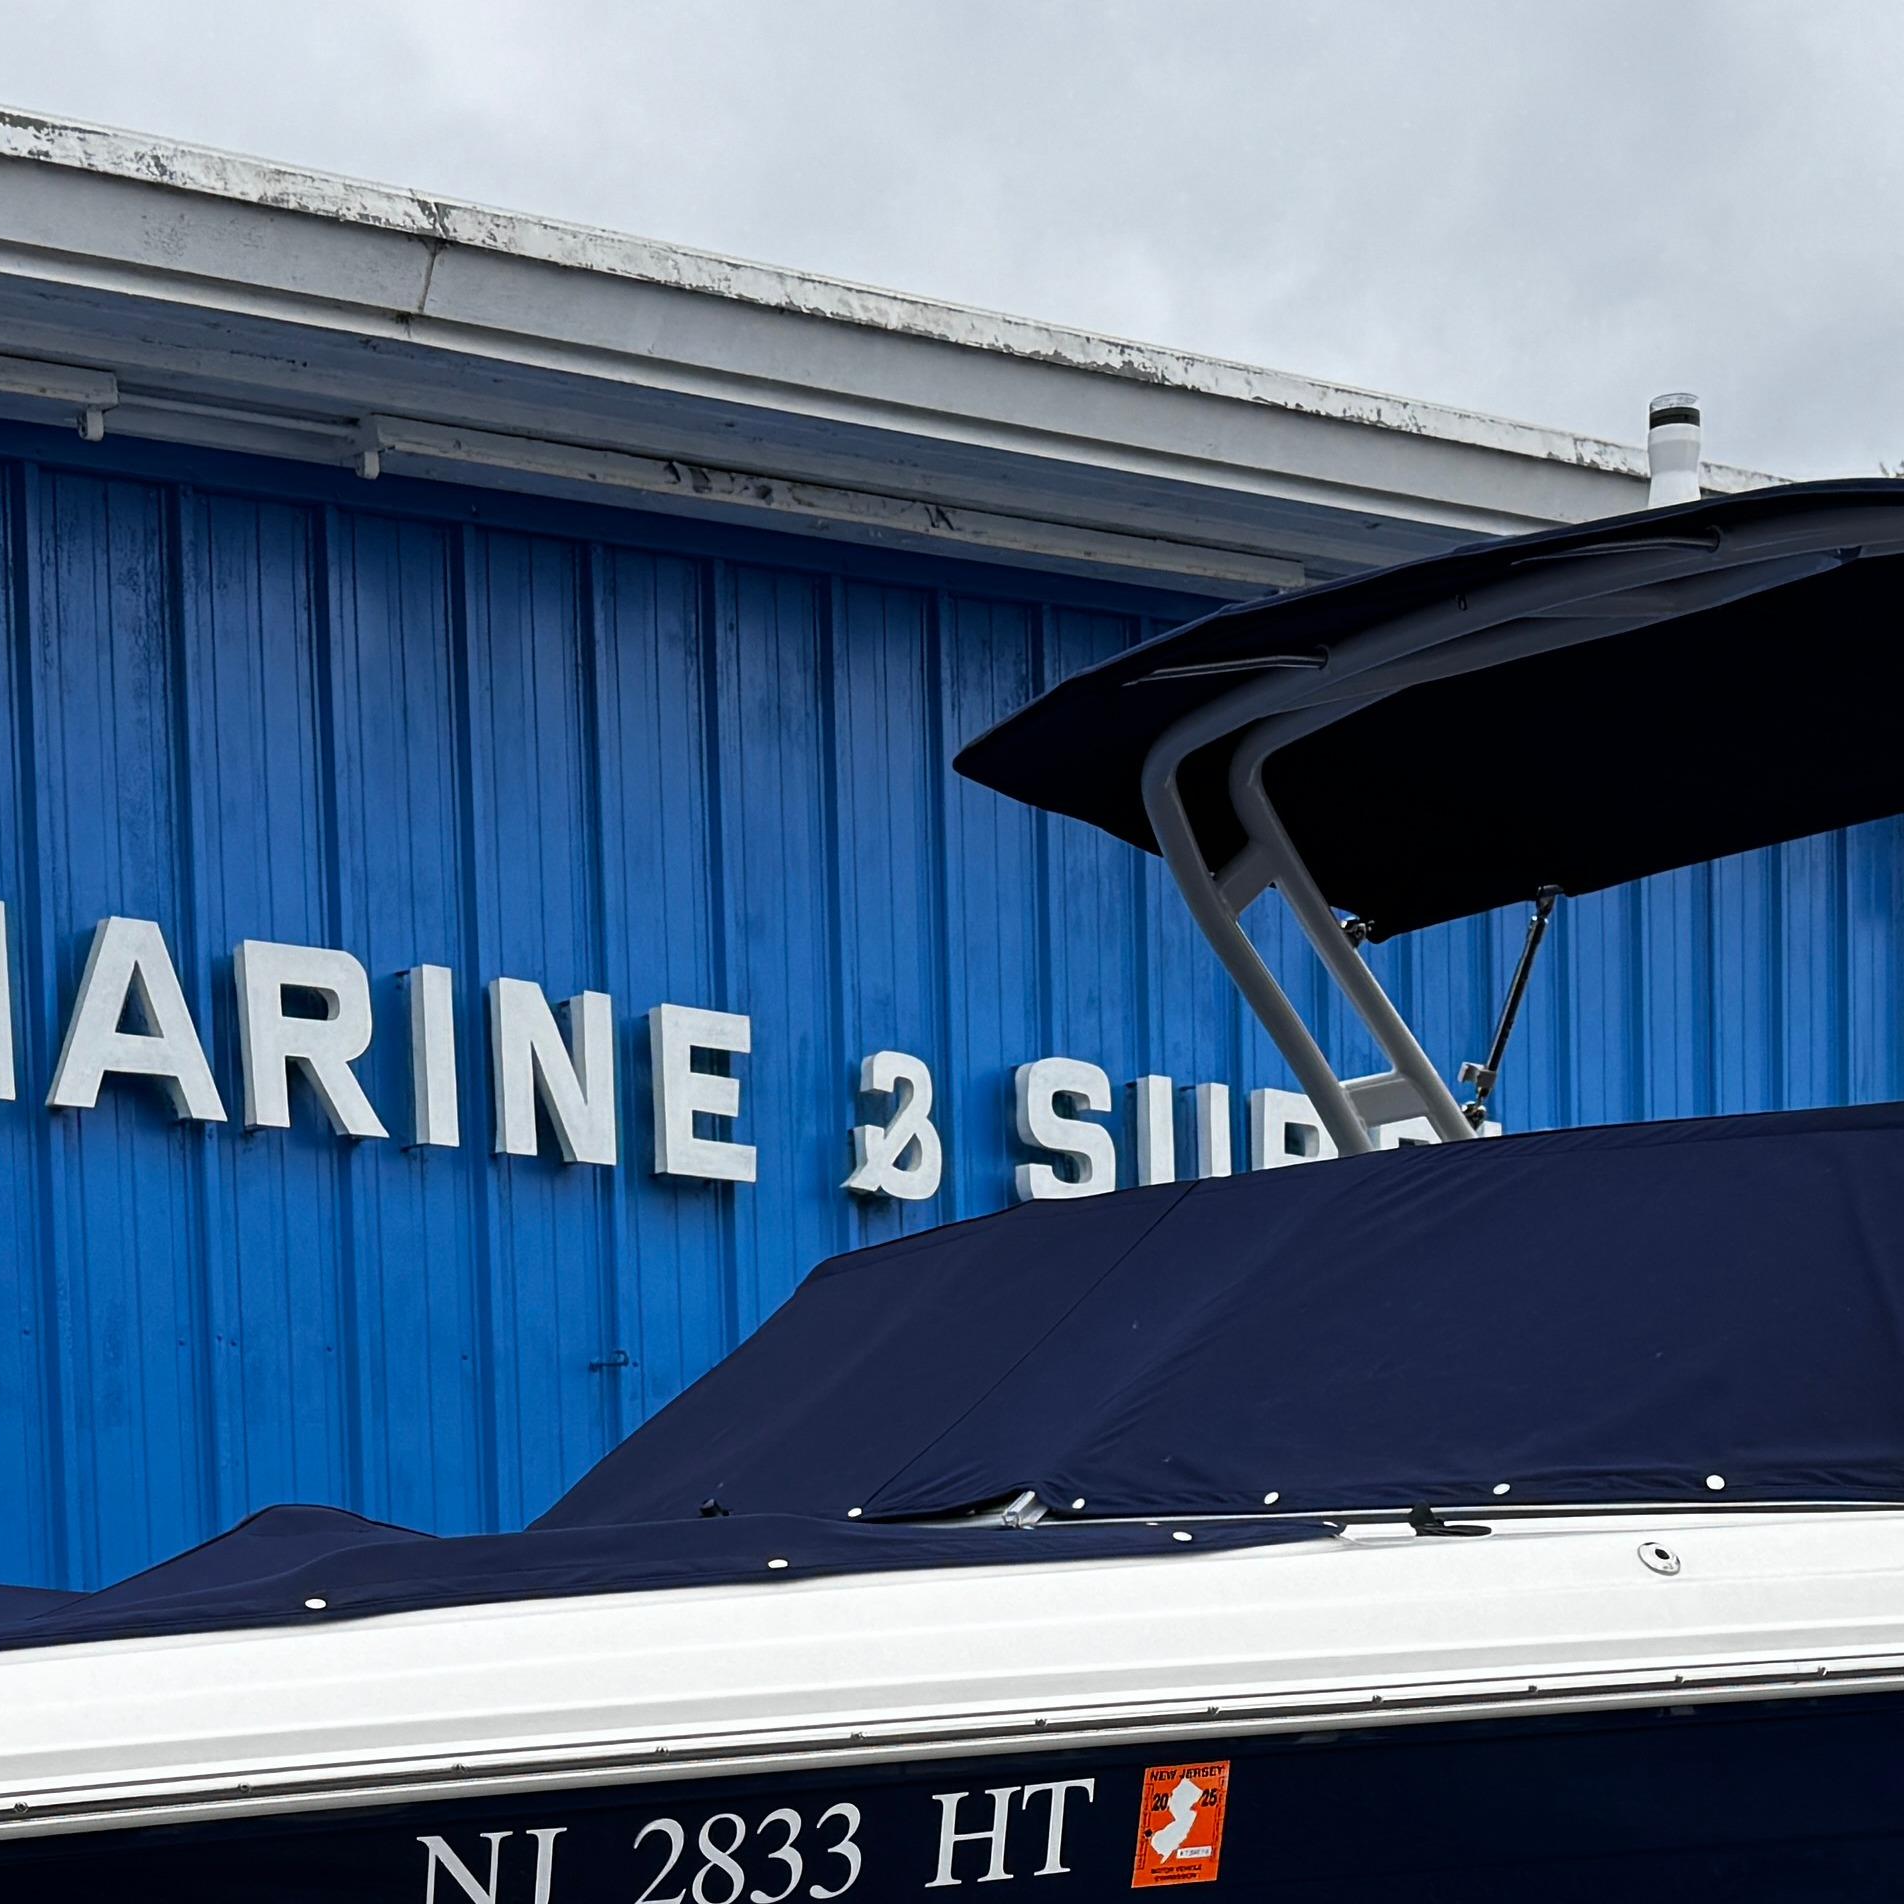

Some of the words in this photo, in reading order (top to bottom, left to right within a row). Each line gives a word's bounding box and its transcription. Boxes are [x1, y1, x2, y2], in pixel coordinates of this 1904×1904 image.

[839, 1049, 942, 1201] &
[1149, 1768, 1177, 1782] NEW
[1179, 1765, 1225, 1780] JERSEY
[925, 1776, 1096, 1890] HT
